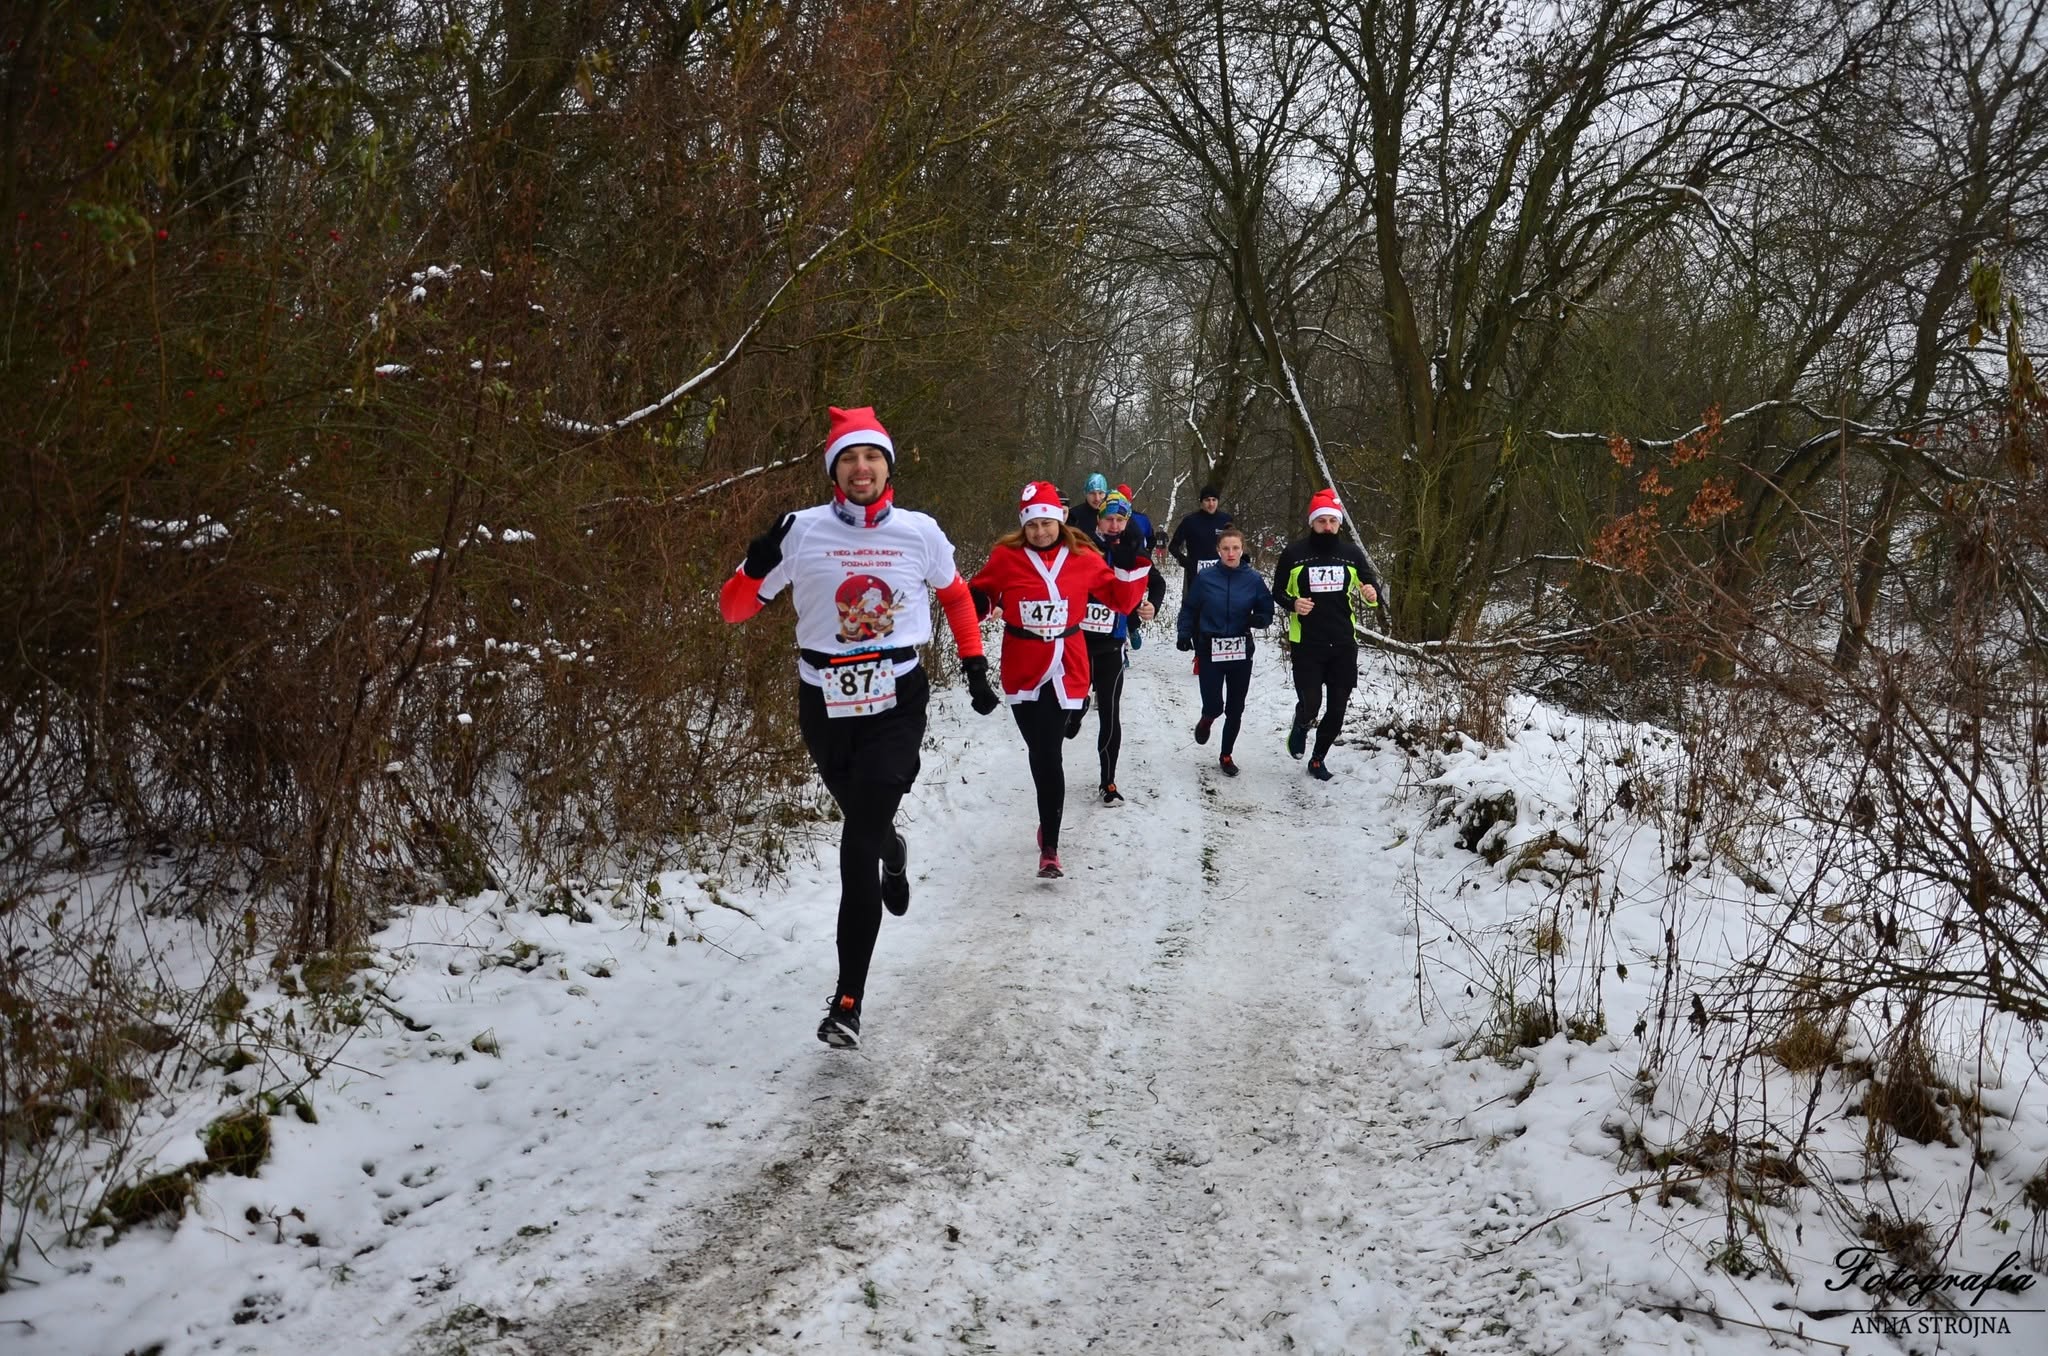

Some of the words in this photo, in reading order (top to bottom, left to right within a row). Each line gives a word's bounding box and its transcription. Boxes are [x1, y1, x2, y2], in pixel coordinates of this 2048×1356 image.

[1318, 569, 1334, 581] 71
[1031, 604, 1055, 621] 47
[1085, 606, 1111, 621] 109
[1217, 640, 1240, 651] 121
[840, 668, 874, 696] 87
